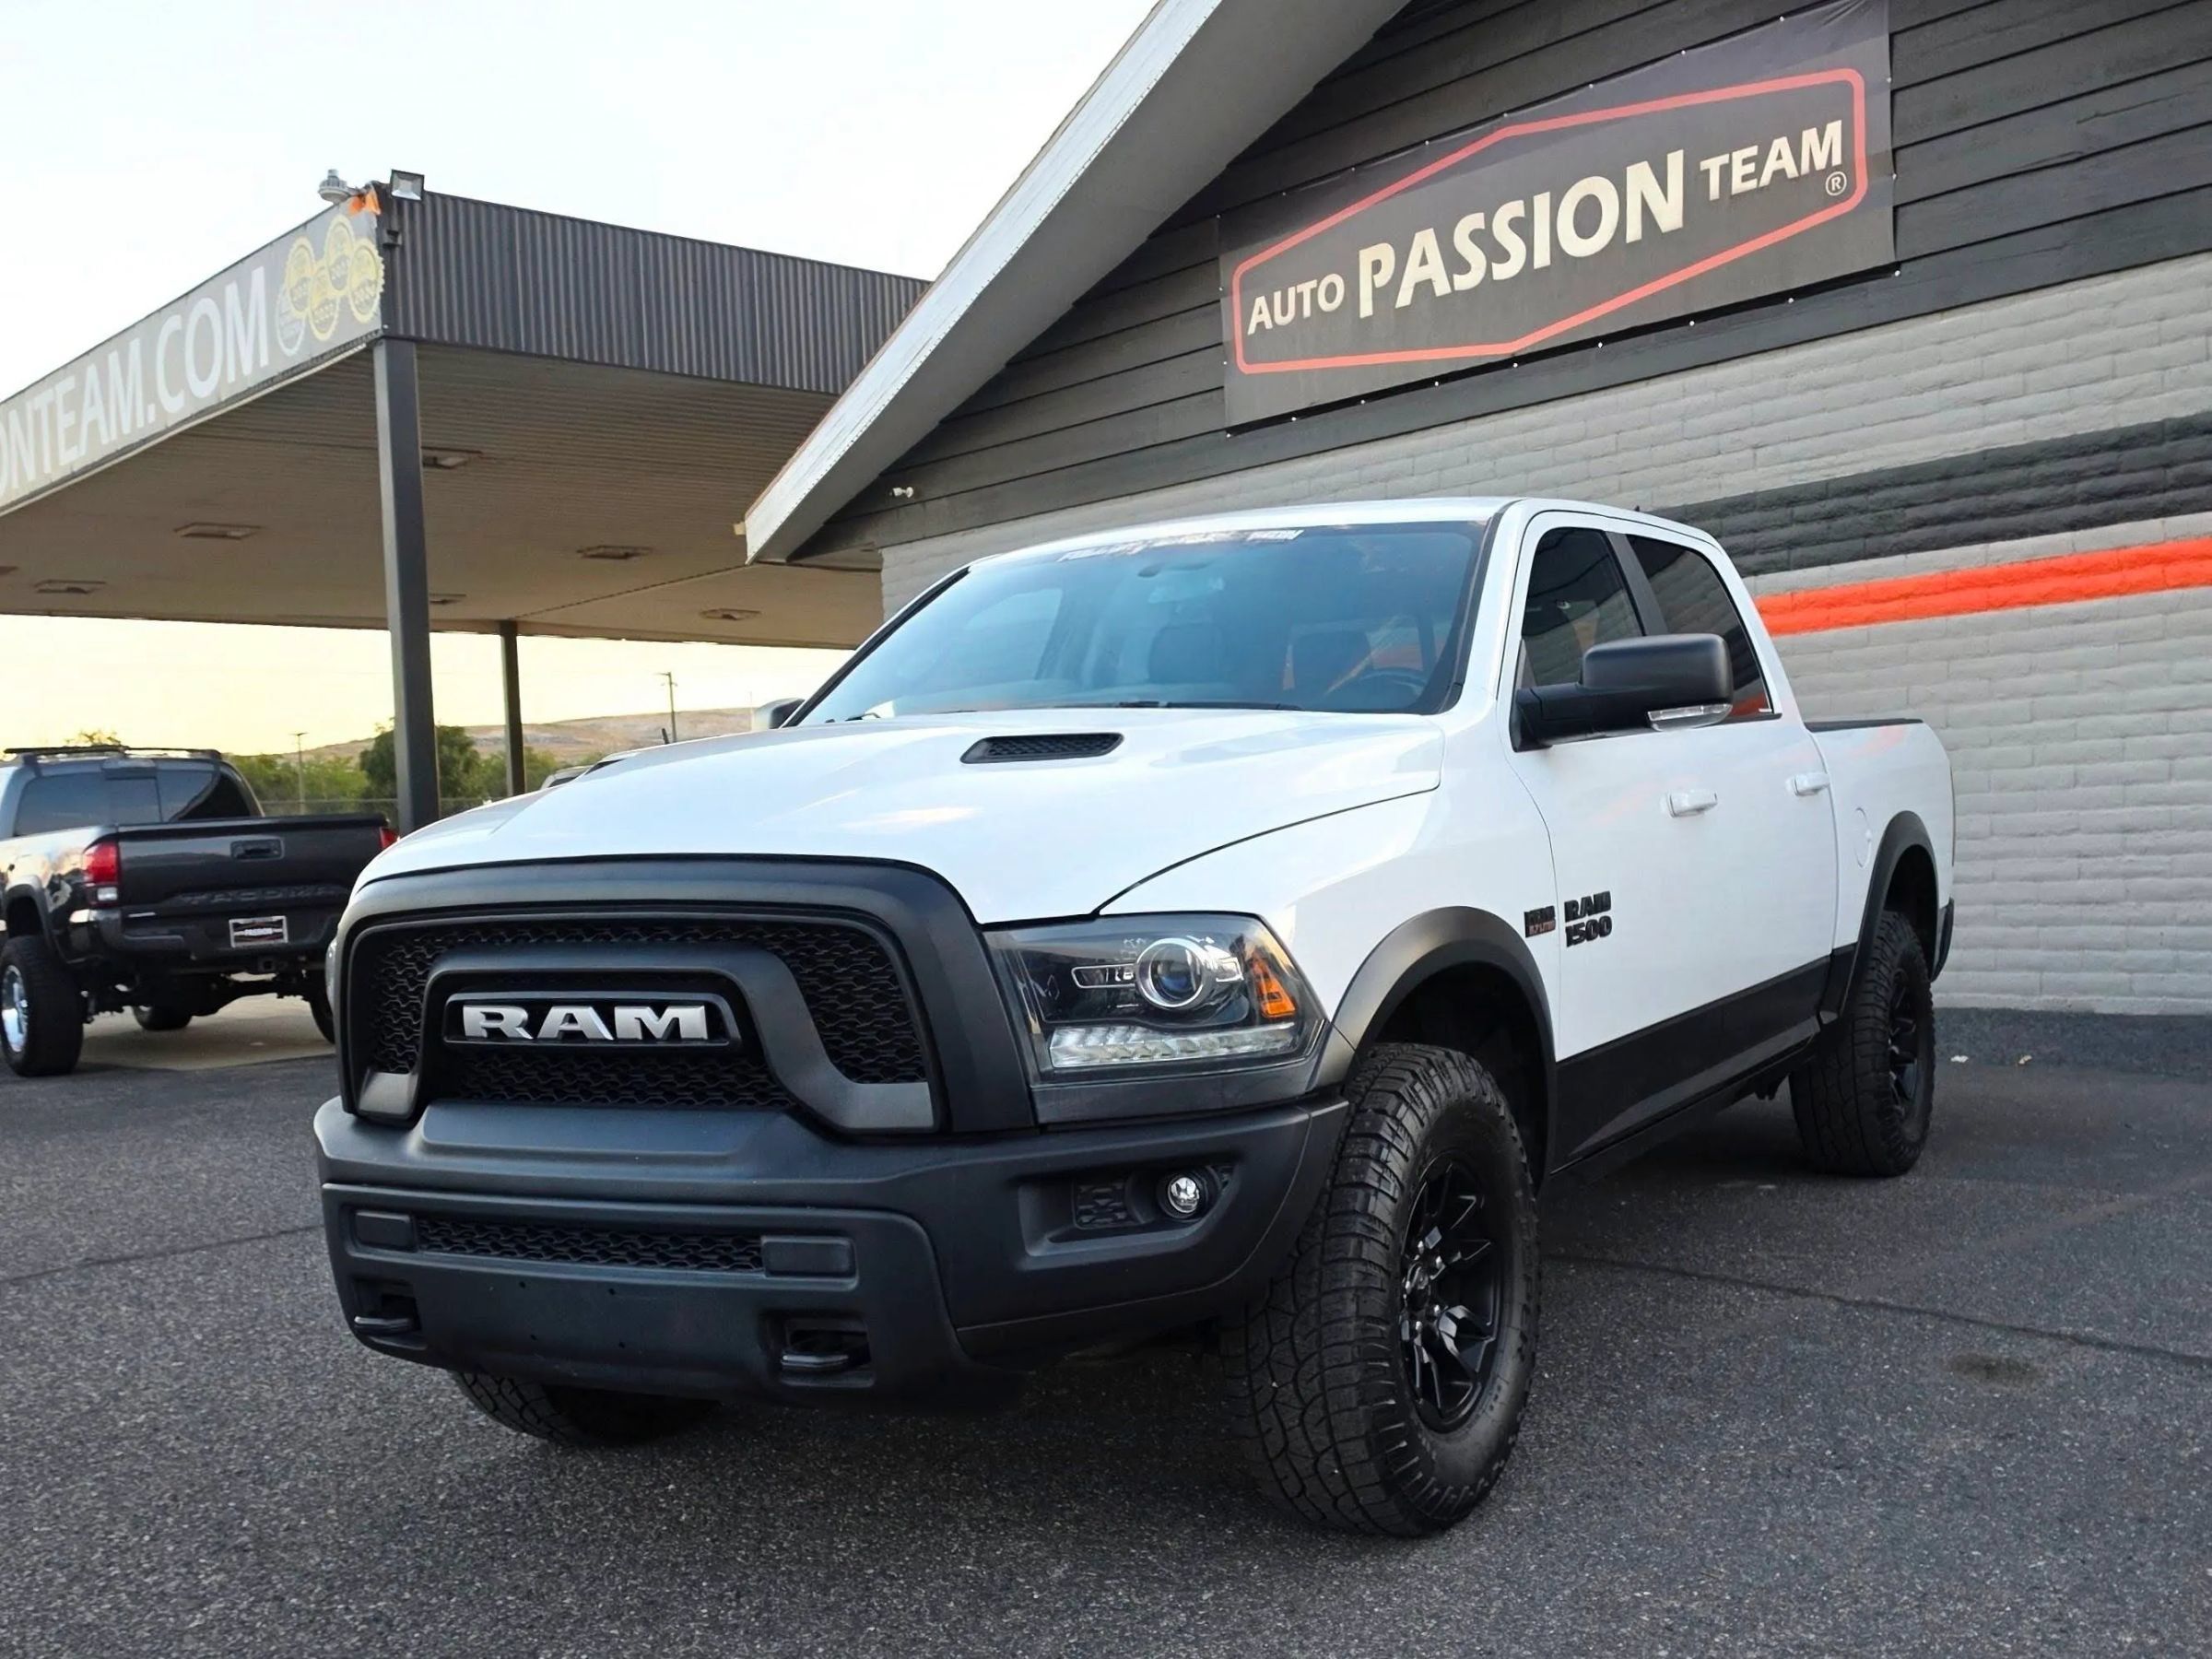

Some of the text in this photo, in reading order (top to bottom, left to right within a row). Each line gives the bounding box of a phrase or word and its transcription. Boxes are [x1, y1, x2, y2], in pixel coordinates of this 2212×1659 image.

[1248, 272, 1344, 335] AUTO
[1359, 150, 1685, 318] PASSION
[1700, 120, 1841, 201] TEAM
[1564, 890, 1611, 923] RAM
[1565, 915, 1612, 947] 1500
[463, 1005, 708, 1041] RAM
